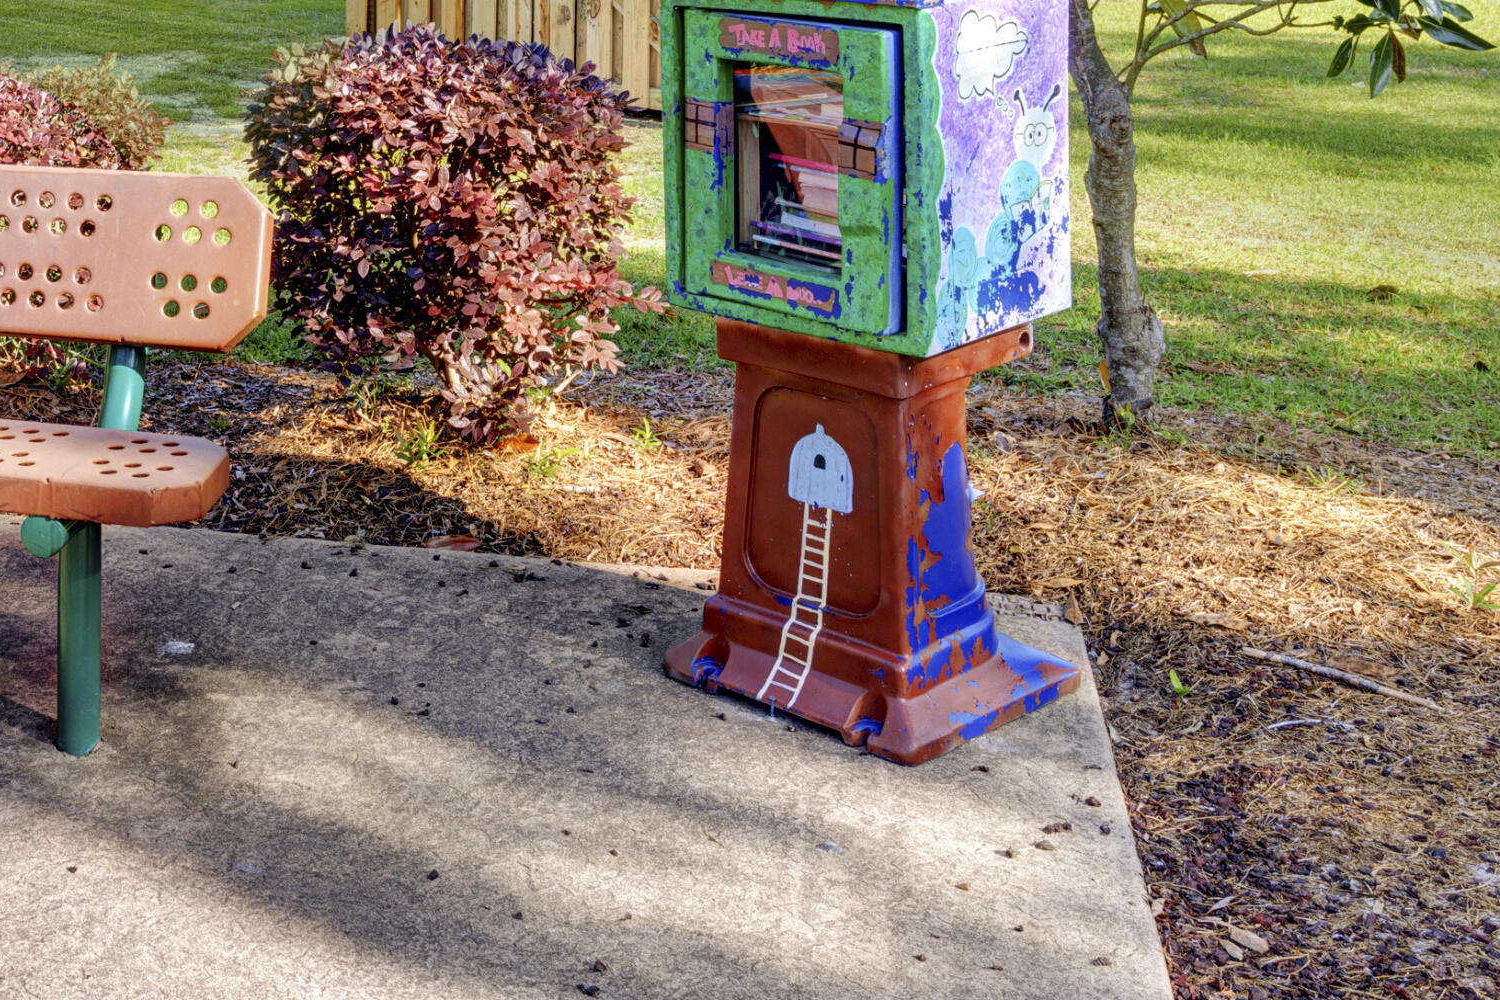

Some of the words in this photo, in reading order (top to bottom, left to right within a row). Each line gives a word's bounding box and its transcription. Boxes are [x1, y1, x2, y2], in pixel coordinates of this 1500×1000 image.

[728, 23, 765, 48] TAKE
[769, 28, 781, 48] A
[766, 276, 784, 298] A
